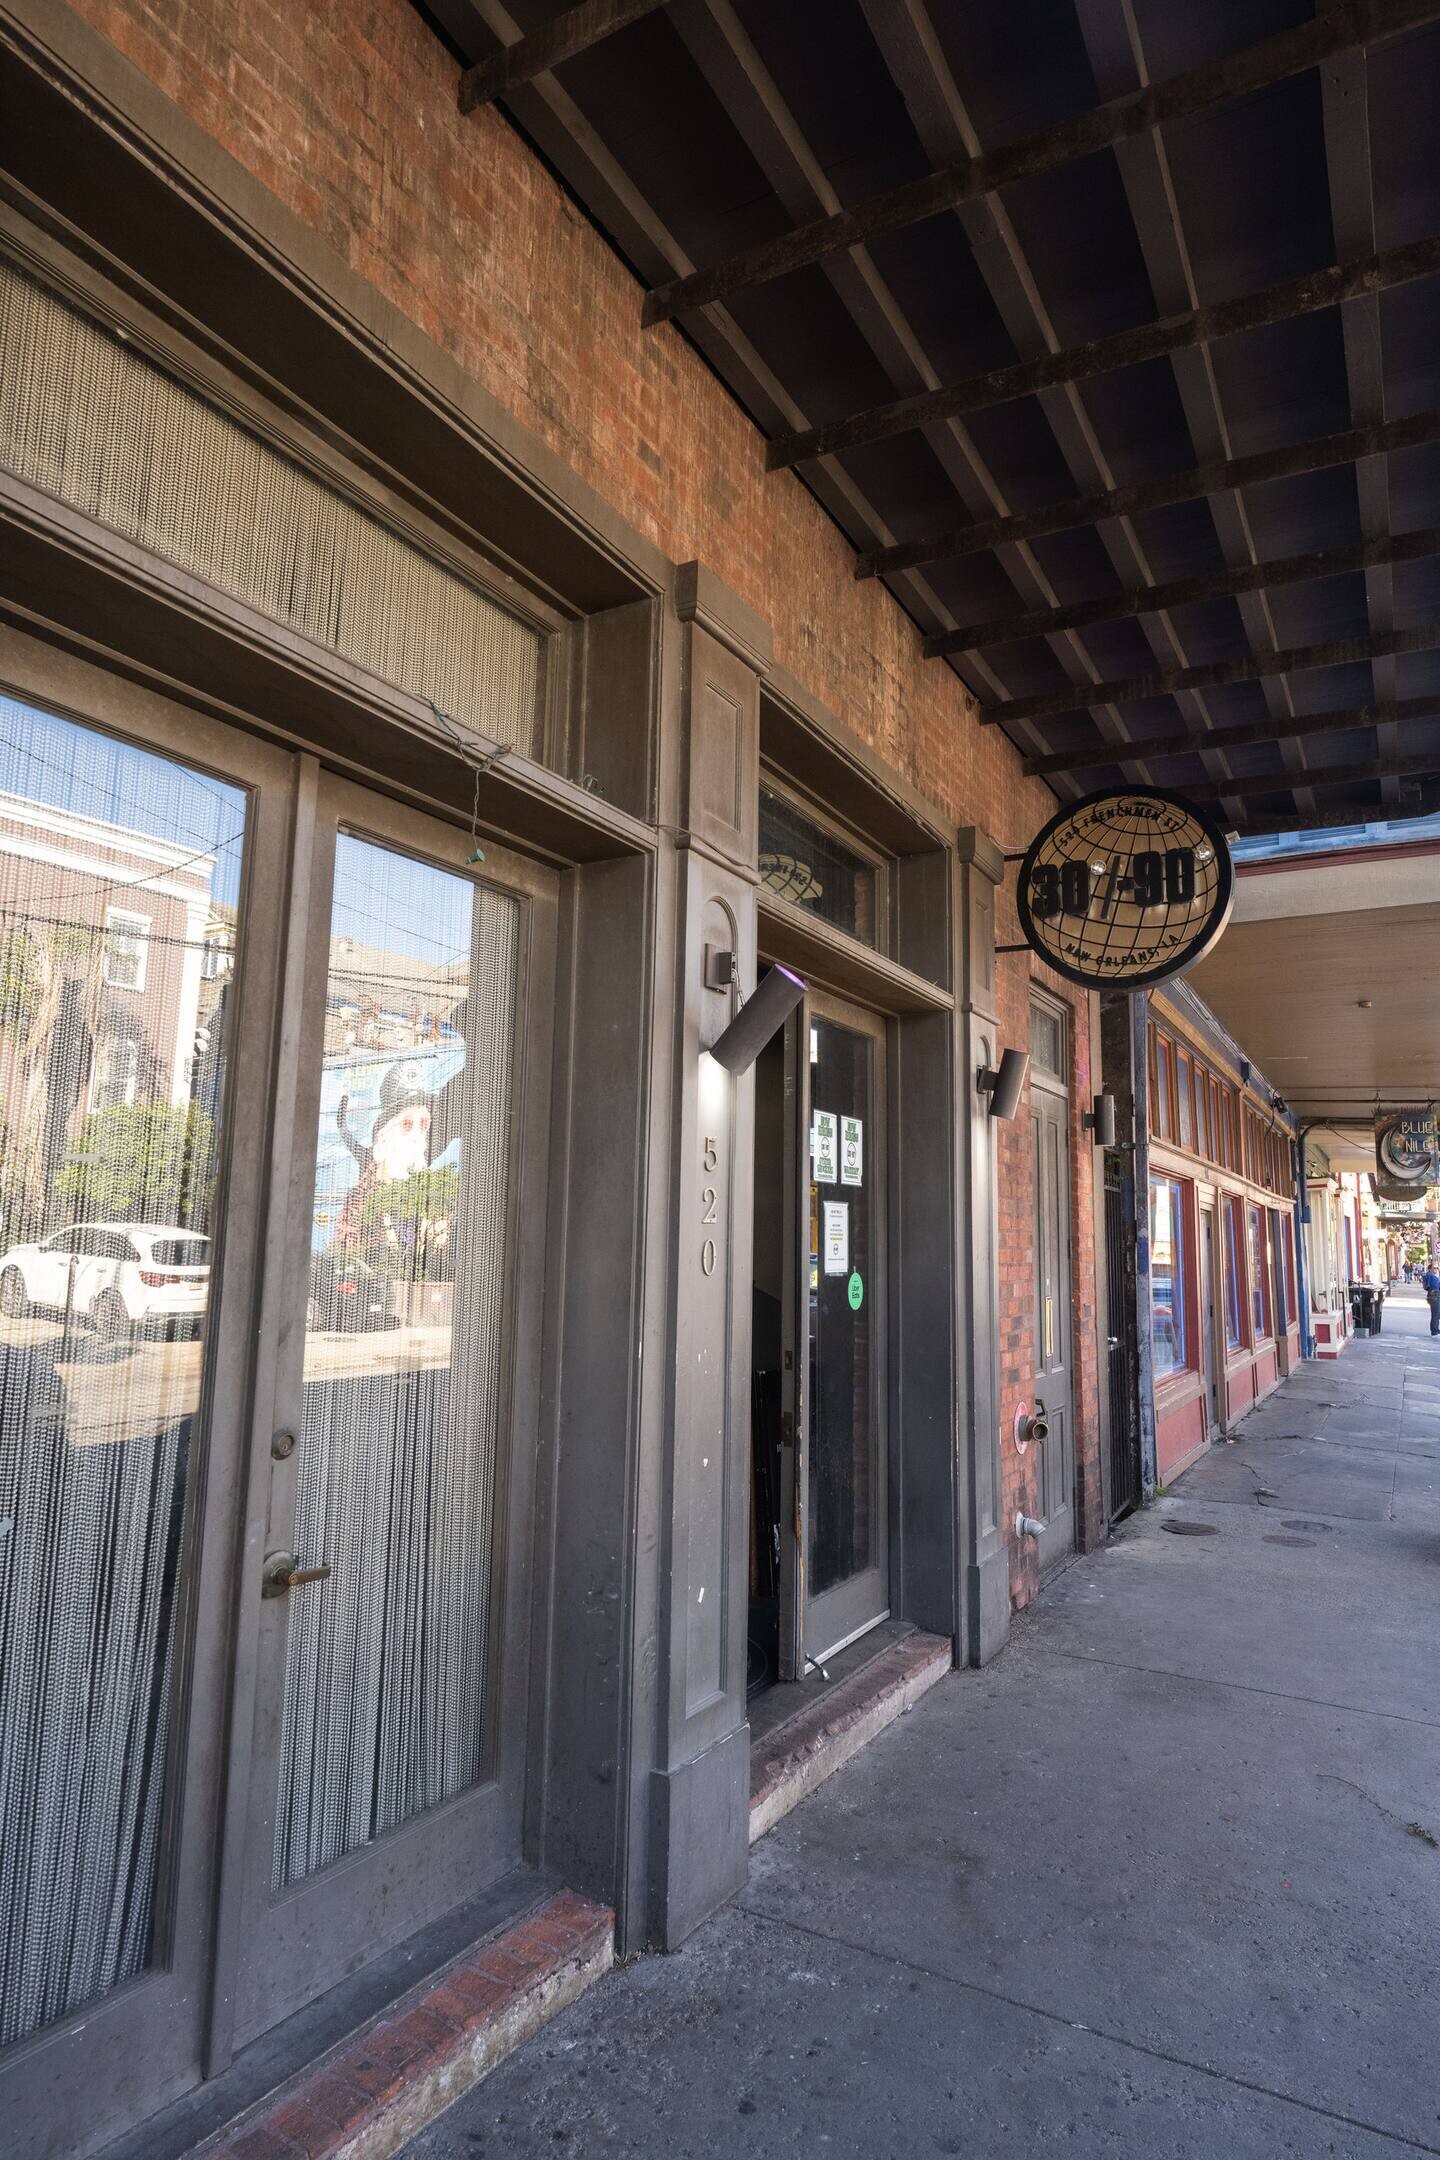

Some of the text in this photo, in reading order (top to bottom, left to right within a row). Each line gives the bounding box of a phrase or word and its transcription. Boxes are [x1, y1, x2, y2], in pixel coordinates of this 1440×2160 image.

[1065, 943, 1092, 962] NEW
[1162, 934, 1180, 948] LA
[1401, 1121, 1433, 1134] BLUE
[702, 1136, 719, 1276] 520
